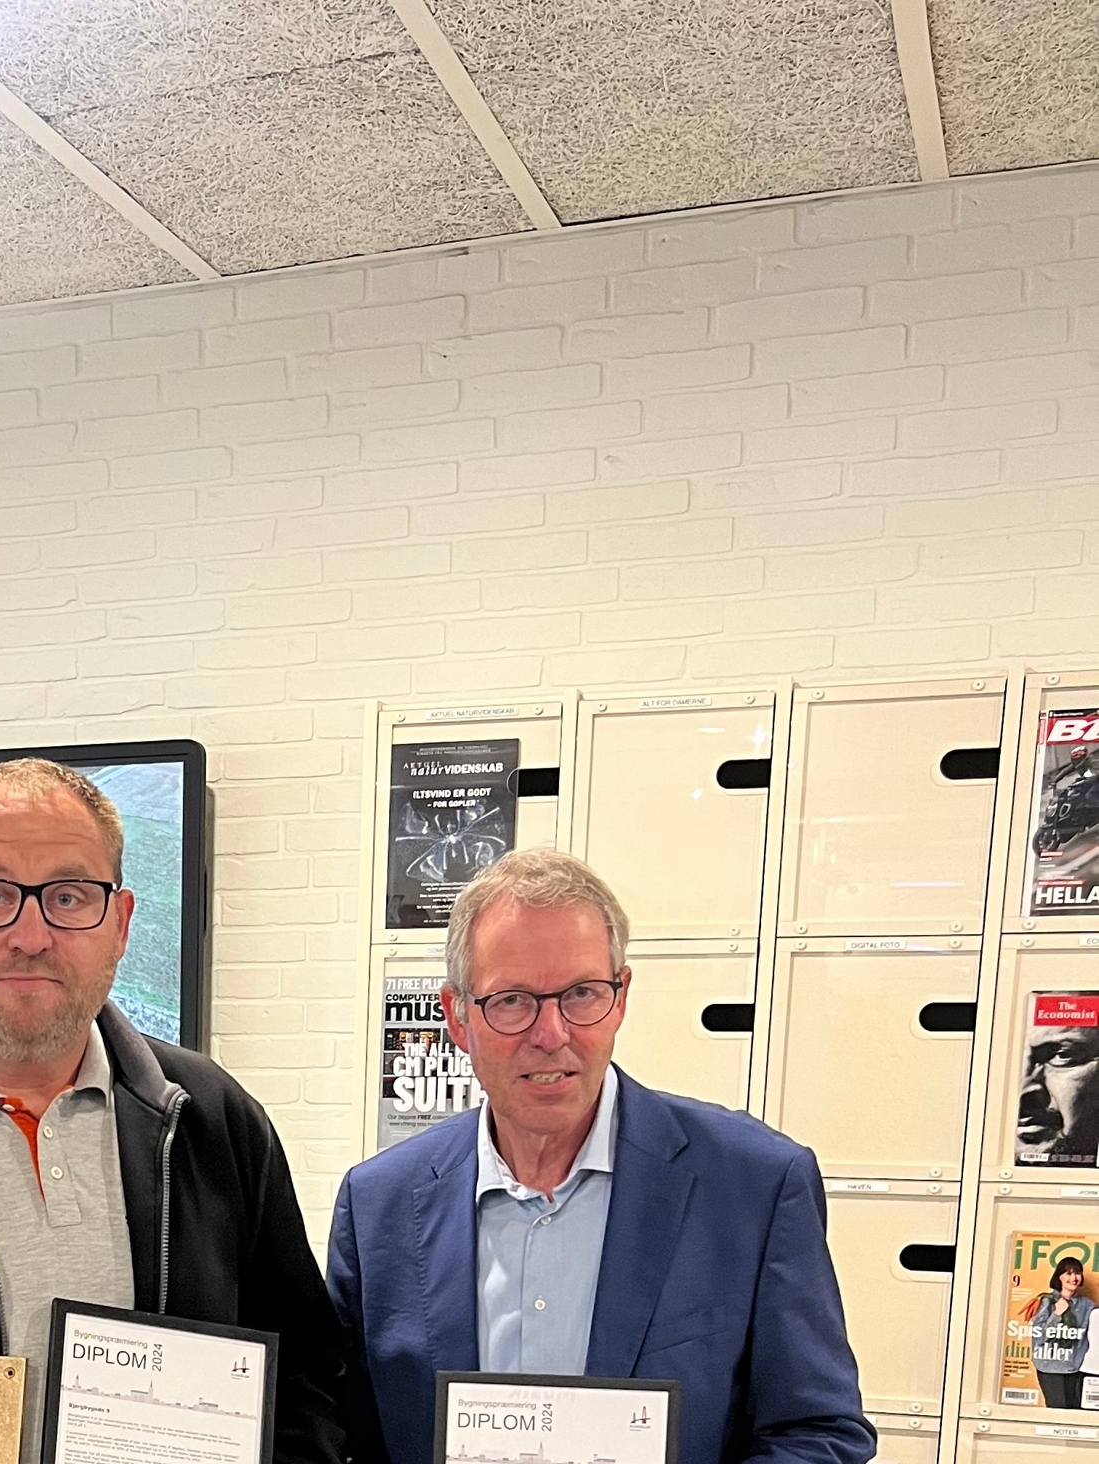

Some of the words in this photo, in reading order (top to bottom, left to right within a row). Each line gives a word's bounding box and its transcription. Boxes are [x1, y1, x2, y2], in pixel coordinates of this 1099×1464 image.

[453, 788, 466, 798] ER
[467, 787, 492, 797] GODT
[386, 979, 396, 990] 71
[397, 979, 421, 990] FREE
[385, 993, 440, 1002] COMPUTER
[385, 1002, 446, 1022] mus
[1058, 1001, 1077, 1011] The
[1037, 1009, 1096, 1019] Economist
[402, 1043, 427, 1056] THE
[429, 1043, 453, 1056] ALL
[393, 1056, 421, 1076] CM
[424, 1056, 475, 1077] PLUG
[1012, 1275, 1021, 1287] 9
[1007, 1320, 1042, 1341] Spis
[1045, 1322, 1085, 1340] efter
[1005, 1340, 1031, 1358] din
[1033, 1342, 1074, 1361] alder
[72, 1343, 147, 1370] DIPLOM
[152, 1343, 163, 1372] 2024
[457, 1412, 535, 1431] DIPLOM
[541, 1402, 553, 1432] 2024
